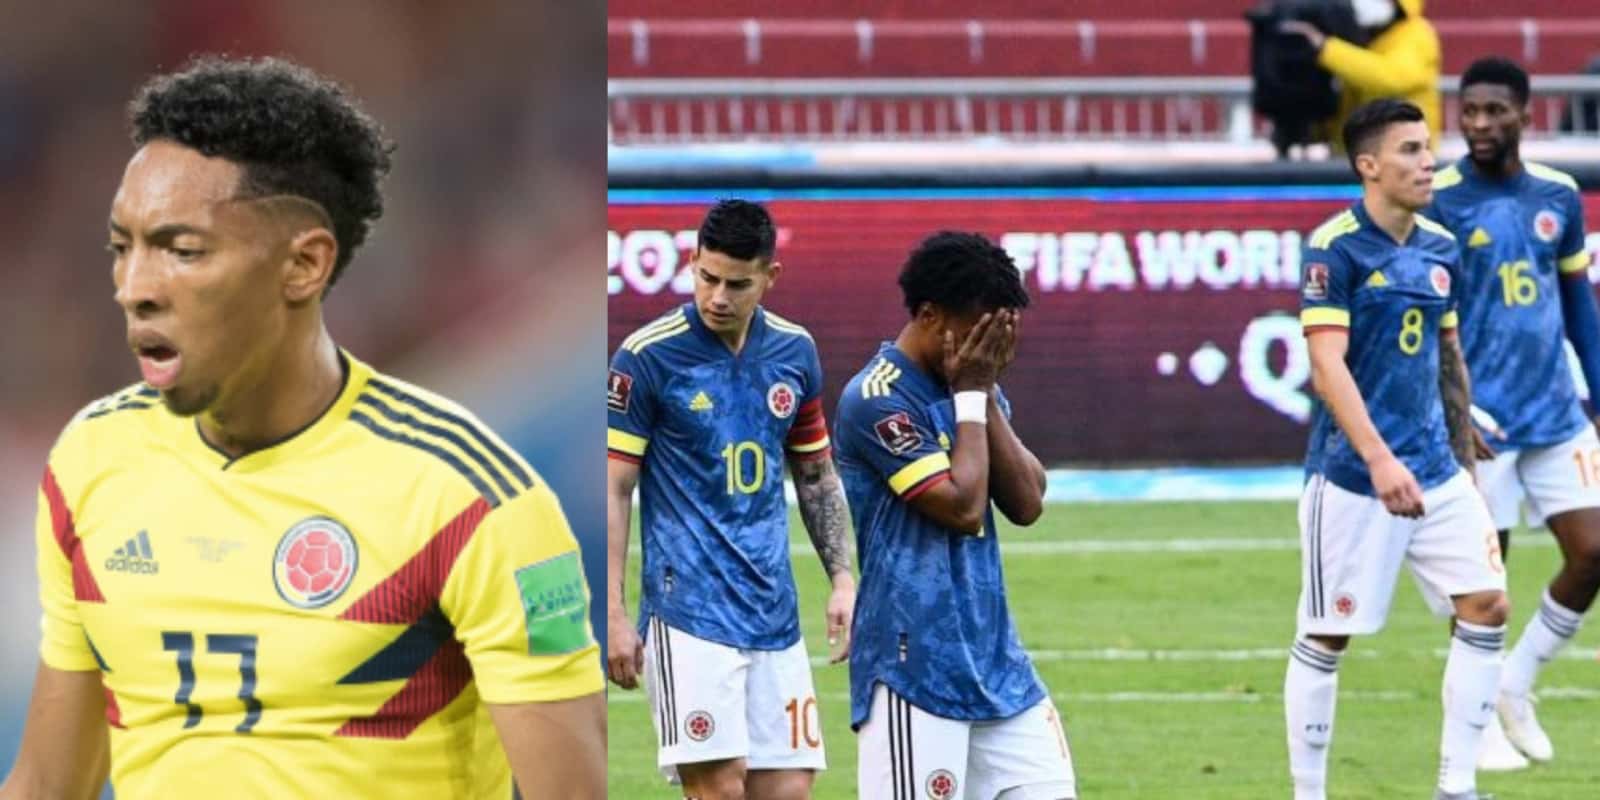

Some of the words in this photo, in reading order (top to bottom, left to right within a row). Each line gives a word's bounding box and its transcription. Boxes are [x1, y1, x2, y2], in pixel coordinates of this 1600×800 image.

[1001, 231, 1137, 291] FIFA
[1498, 260, 1537, 307] 16
[1399, 308, 1423, 355] 8
[721, 441, 764, 495] 10
[104, 557, 159, 575] adidas
[160, 631, 262, 733] 17
[785, 698, 820, 749] 10
